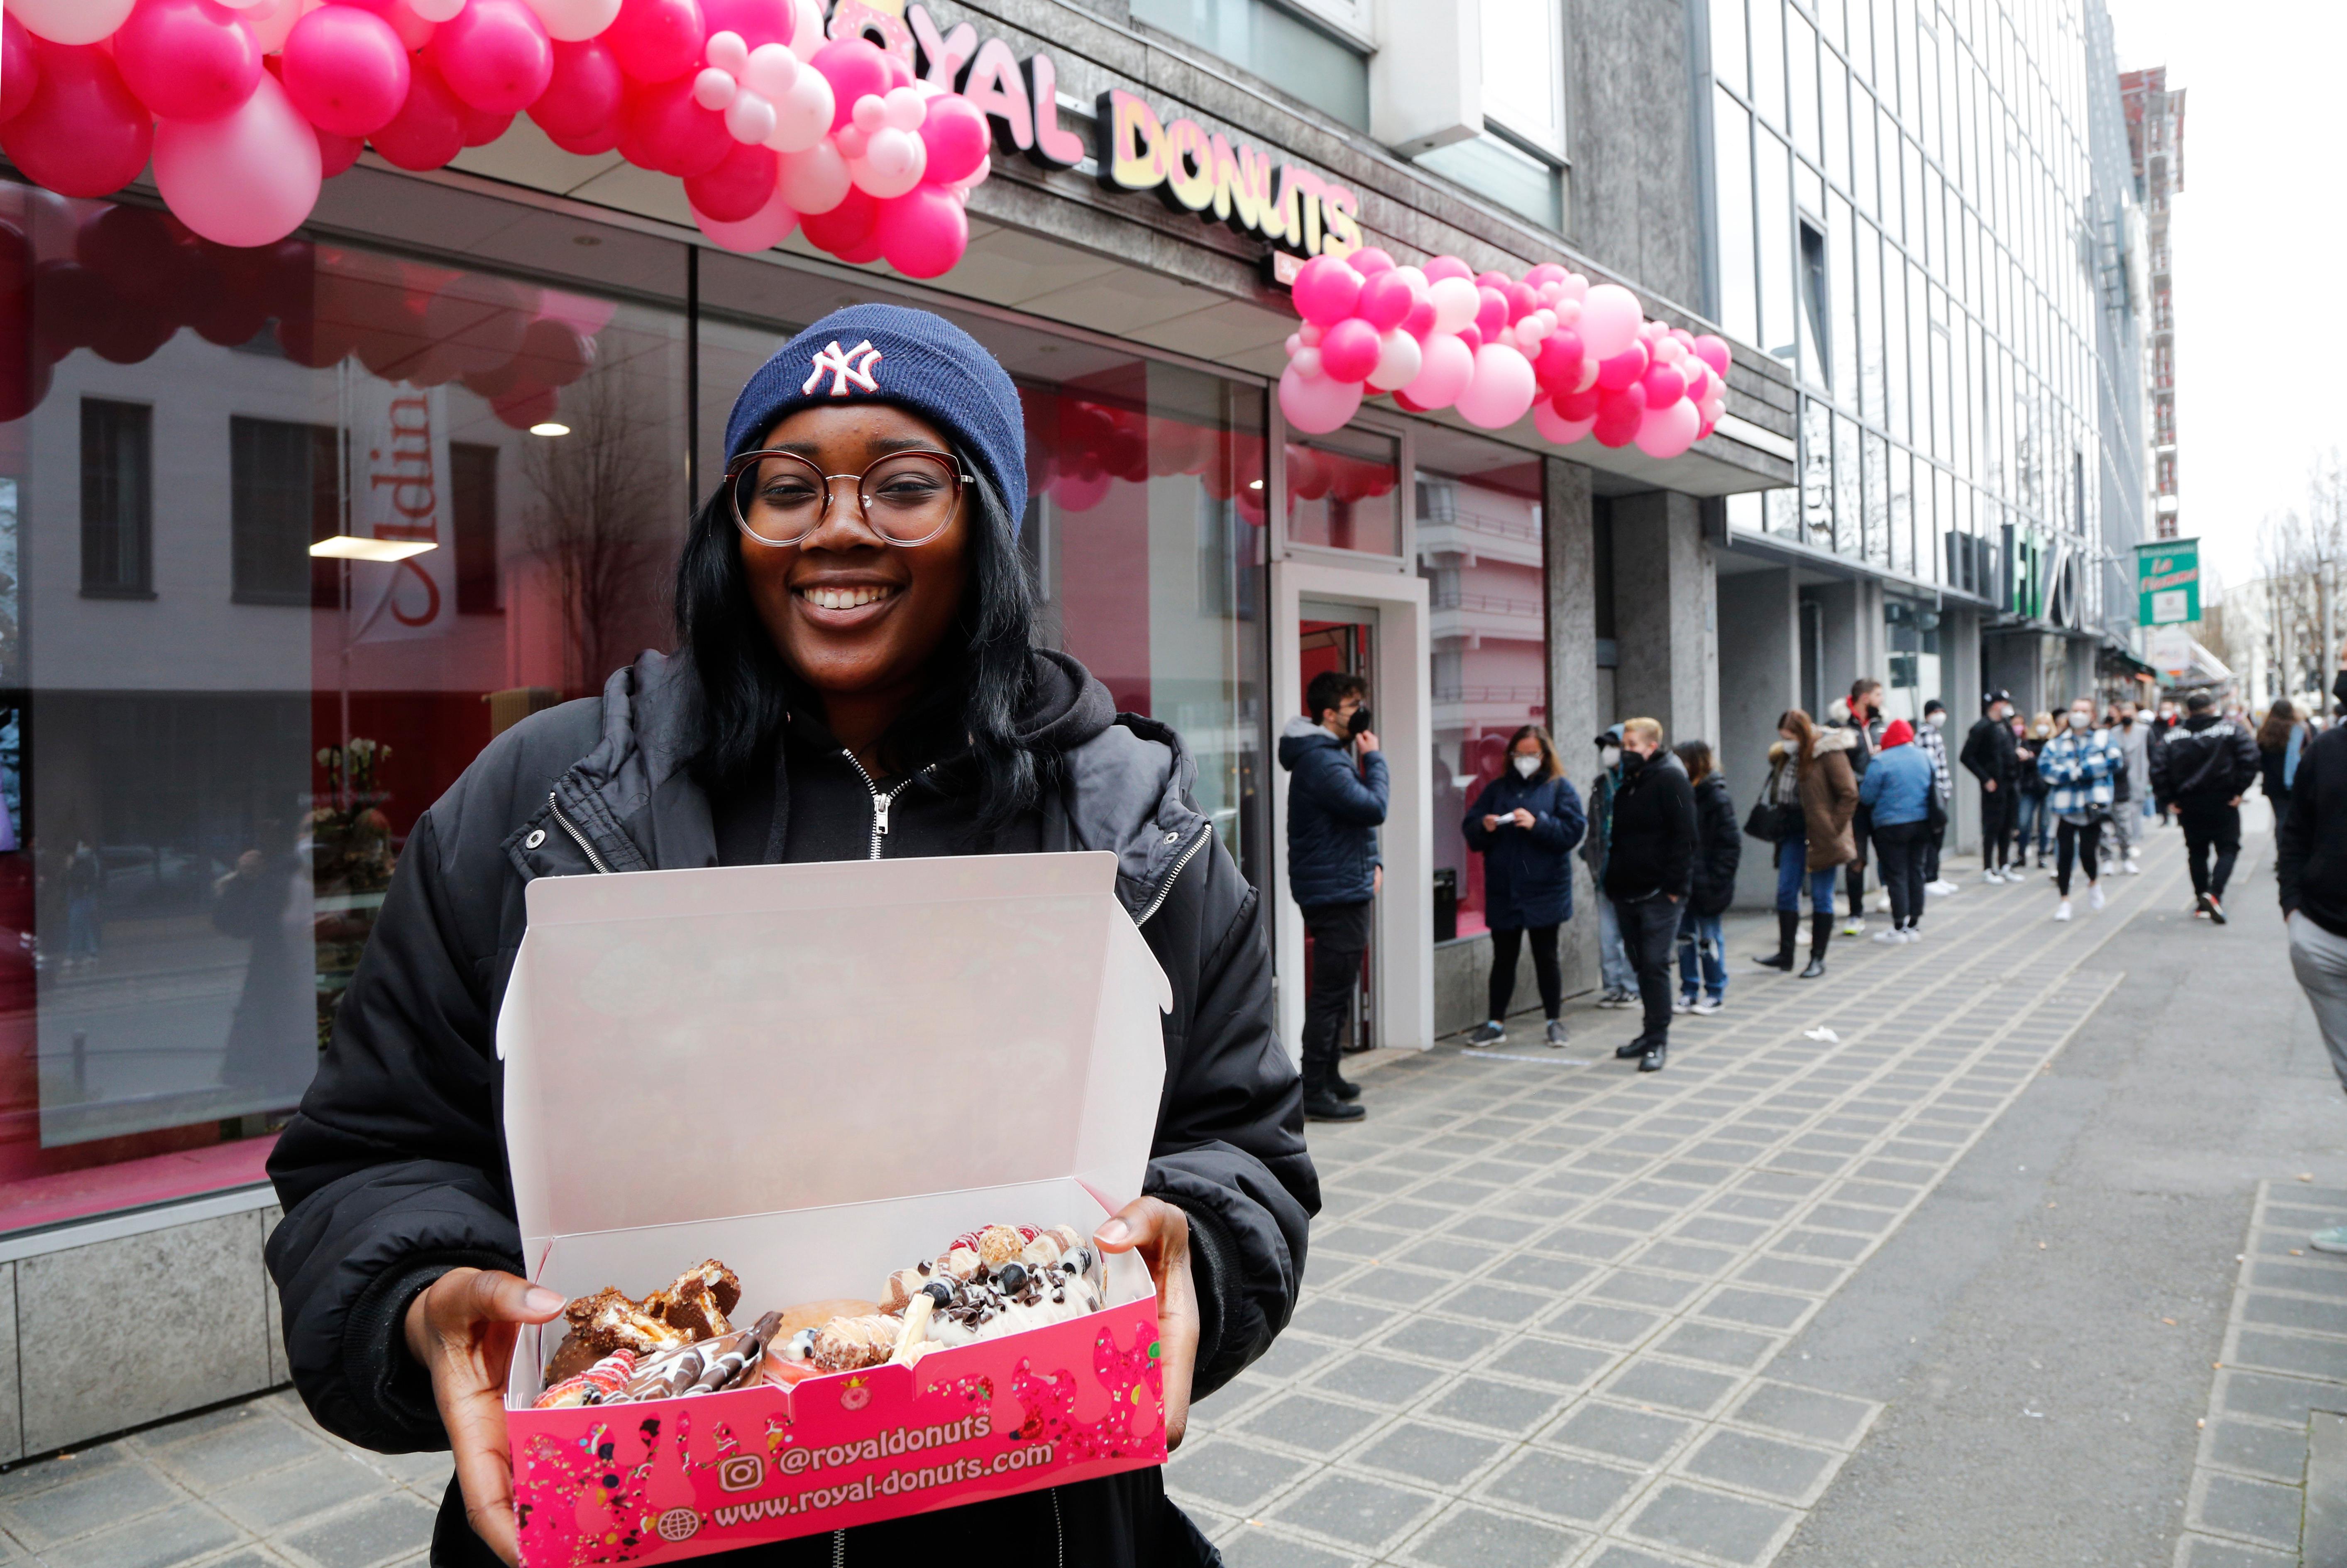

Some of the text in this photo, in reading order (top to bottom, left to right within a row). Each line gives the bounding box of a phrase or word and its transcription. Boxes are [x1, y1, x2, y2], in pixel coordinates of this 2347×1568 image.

[1110, 88, 1364, 259] DONUTS
[714, 1443, 1054, 1528] www.royal-donuts.com
[779, 1414, 992, 1475] @royaldonuts
